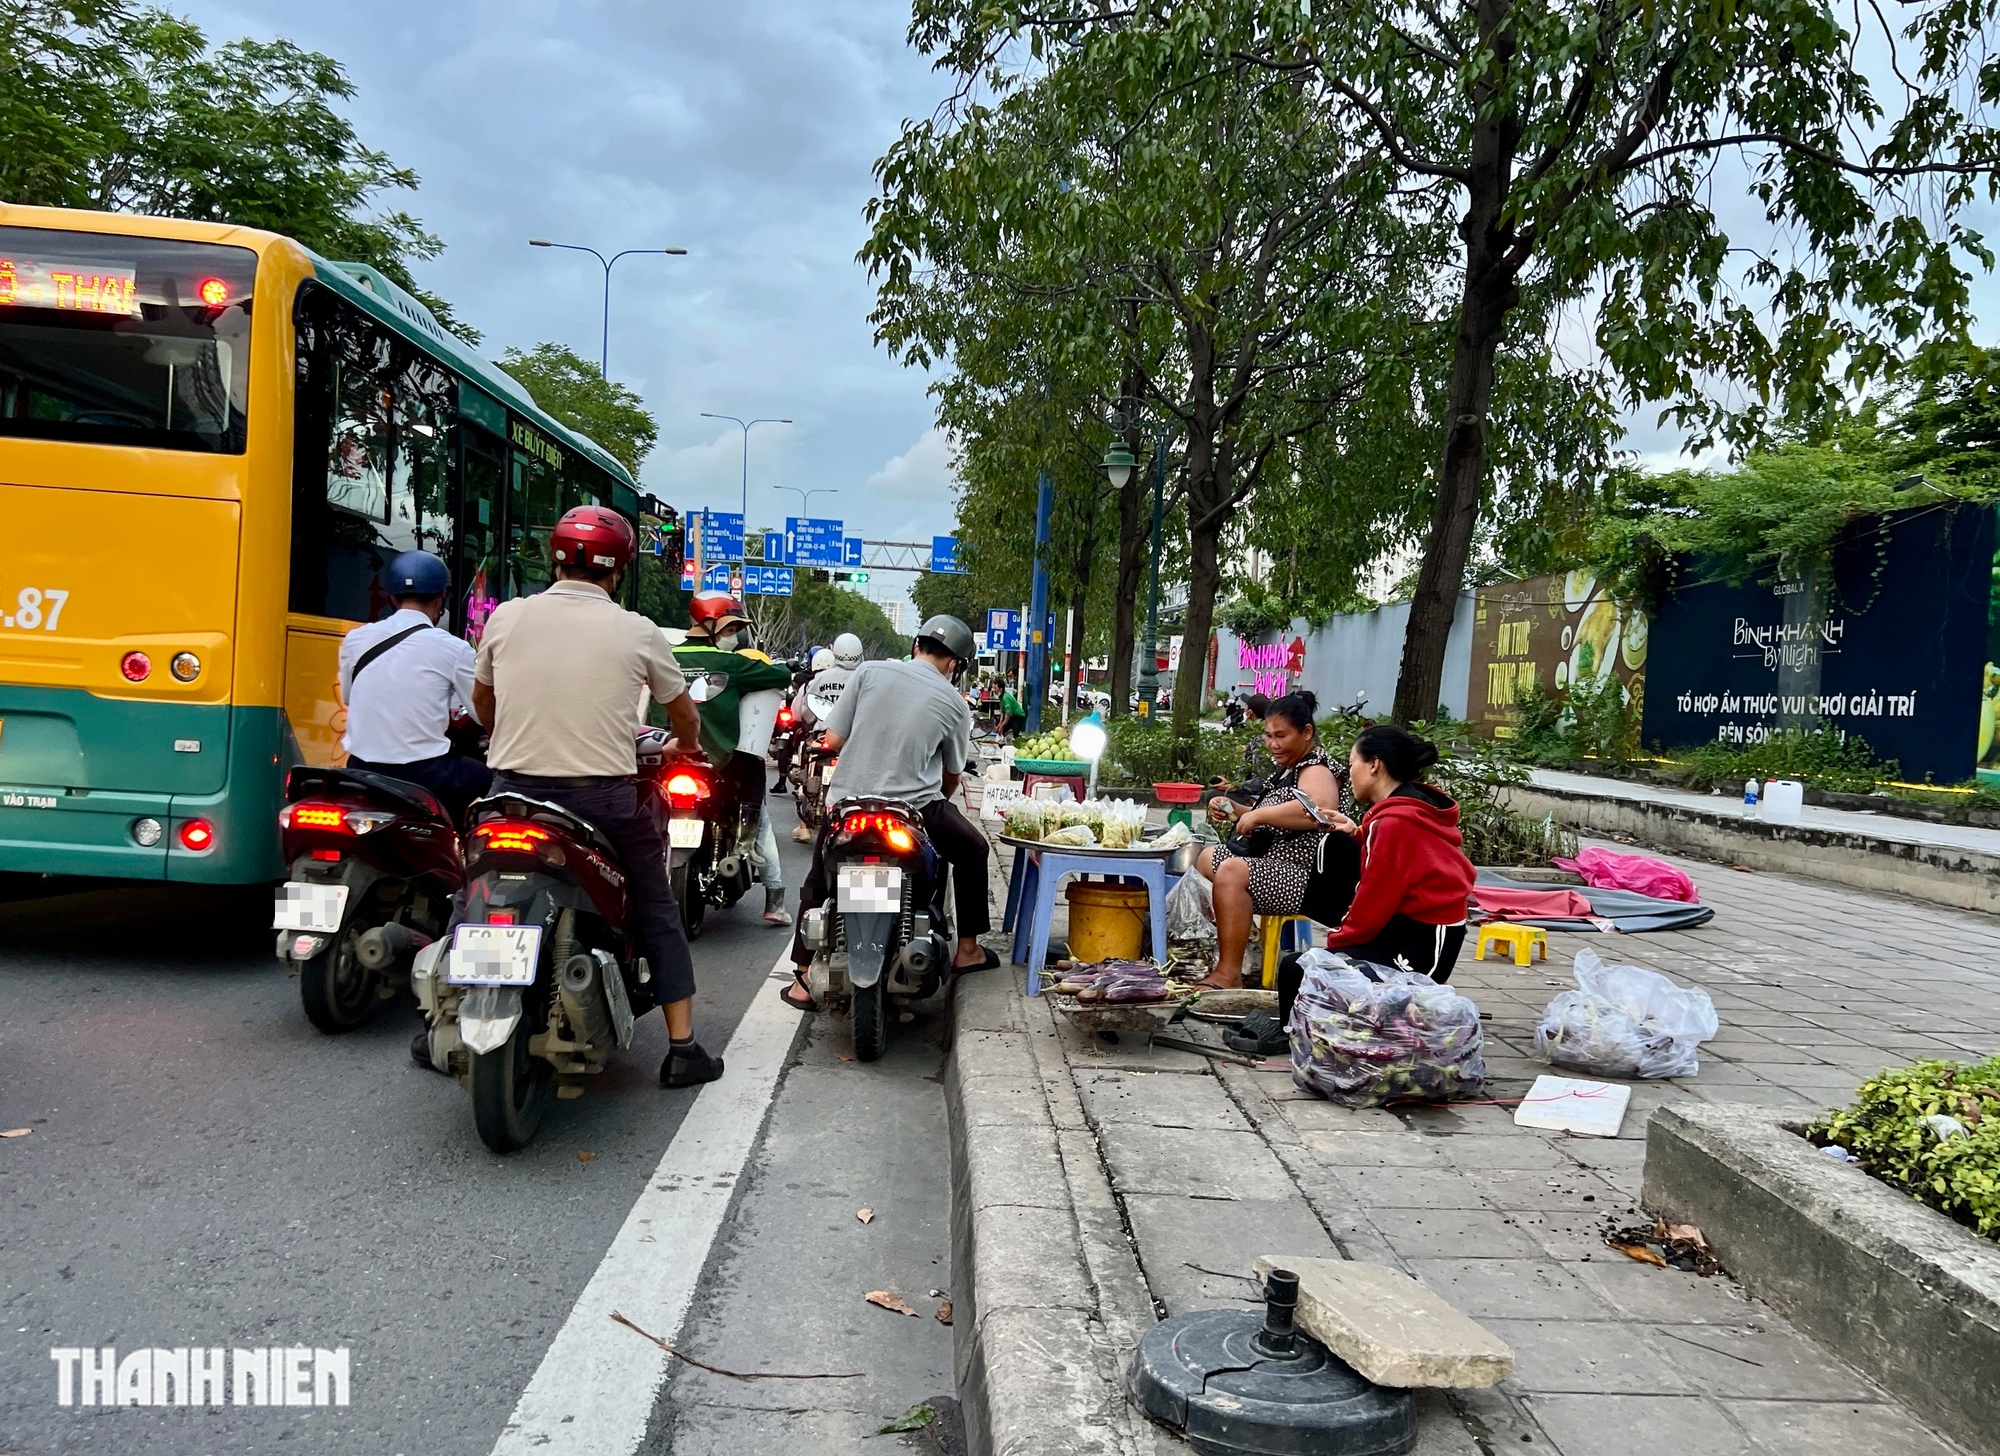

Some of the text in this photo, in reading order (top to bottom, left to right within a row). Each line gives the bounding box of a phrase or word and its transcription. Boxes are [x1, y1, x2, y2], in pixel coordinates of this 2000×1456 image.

[511, 420, 562, 471] XE BUÝT ĐIỆN
[1773, 582, 1805, 596] GLOBAL X
[819, 683, 845, 693] WHEN
[1676, 688, 1918, 719] TỔ HỢP ẨM THỰC VUI CHƠI GIẢI TRÍ
[4, 793, 57, 809] VÀO TRẠM
